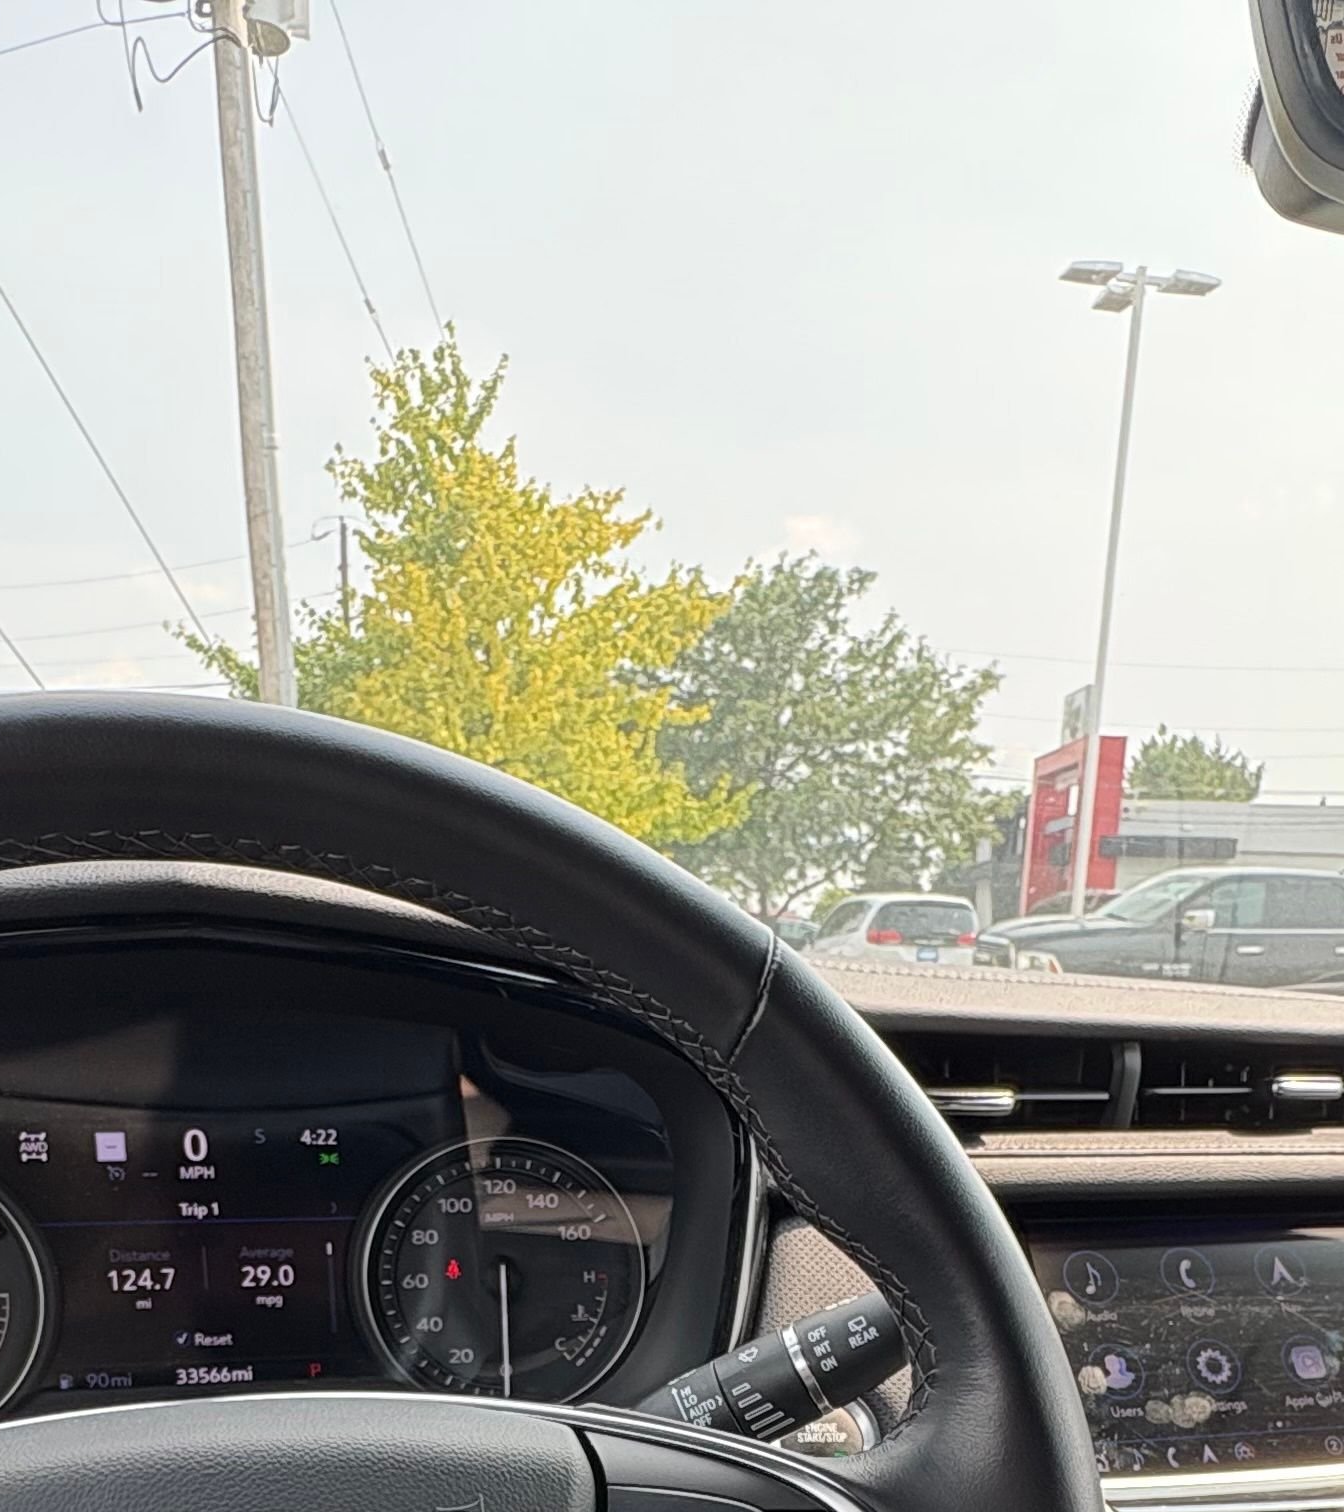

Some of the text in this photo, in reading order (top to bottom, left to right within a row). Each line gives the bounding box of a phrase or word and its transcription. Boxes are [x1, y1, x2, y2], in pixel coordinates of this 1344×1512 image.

[183, 1128, 209, 1162] 0
[254, 1129, 266, 1145] S
[299, 1128, 339, 1146] 4:22
[19, 1140, 48, 1154] AWD
[179, 1165, 216, 1181] MPH
[483, 1178, 517, 1195] 120
[438, 1197, 473, 1214] 100
[526, 1193, 560, 1209] 140
[178, 1201, 220, 1222] Trip 1
[484, 1211, 515, 1223] MPH
[411, 1229, 439, 1246] 80
[558, 1224, 592, 1241] 160
[109, 1248, 172, 1264] Distance
[239, 1245, 295, 1263] Average
[107, 1267, 176, 1292] 124.7
[239, 1264, 296, 1289] 29.0
[402, 1272, 430, 1290] 60
[583, 1271, 596, 1284] H
[135, 1296, 153, 1311] mi
[255, 1293, 284, 1309] mpg
[416, 1316, 444, 1333] 40
[193, 1331, 234, 1348] Reset
[807, 1325, 827, 1343] OFF
[847, 1326, 880, 1349] REAR
[554, 1335, 568, 1353] C
[813, 1340, 832, 1358] INT
[448, 1348, 474, 1365] 20
[820, 1355, 839, 1372] ON
[175, 1365, 254, 1386] 33566mi
[309, 1362, 322, 1378] P
[86, 1373, 133, 1389] 90mi
[680, 1385, 693, 1398] HI
[683, 1394, 699, 1409] LO
[689, 1397, 717, 1420] AUTO
[1285, 1395, 1315, 1411] Apple
[692, 1413, 713, 1428] OFF
[1110, 1405, 1145, 1419] Users
[796, 1431, 849, 1444] START/STOP
